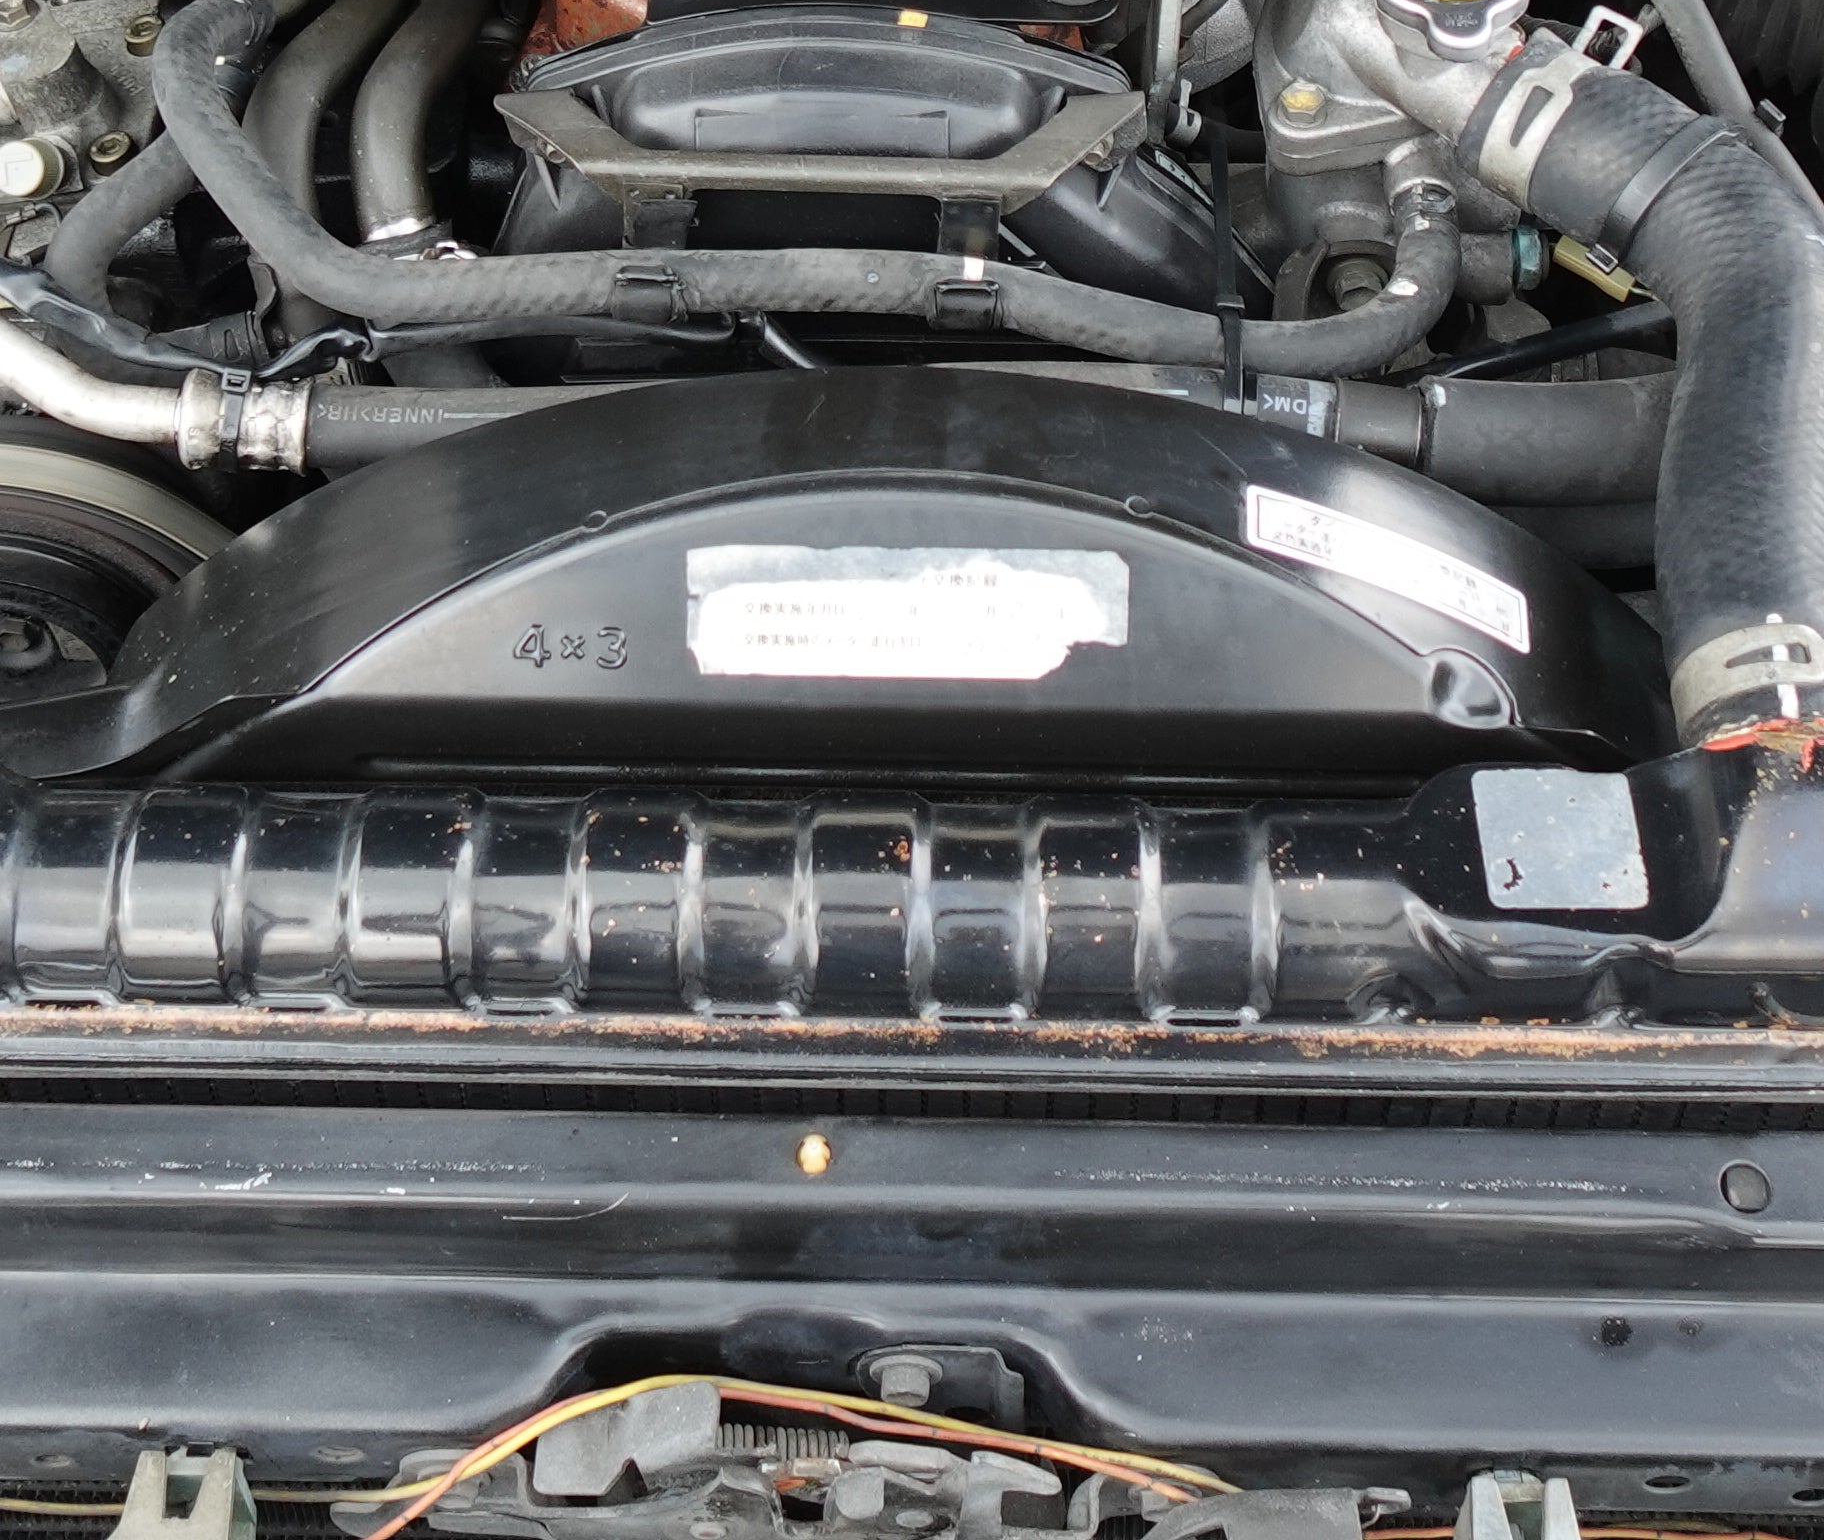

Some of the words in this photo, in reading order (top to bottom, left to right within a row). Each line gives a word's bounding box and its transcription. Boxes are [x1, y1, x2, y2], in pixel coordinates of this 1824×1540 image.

[743, 602, 846, 618] 交換実施年月日
